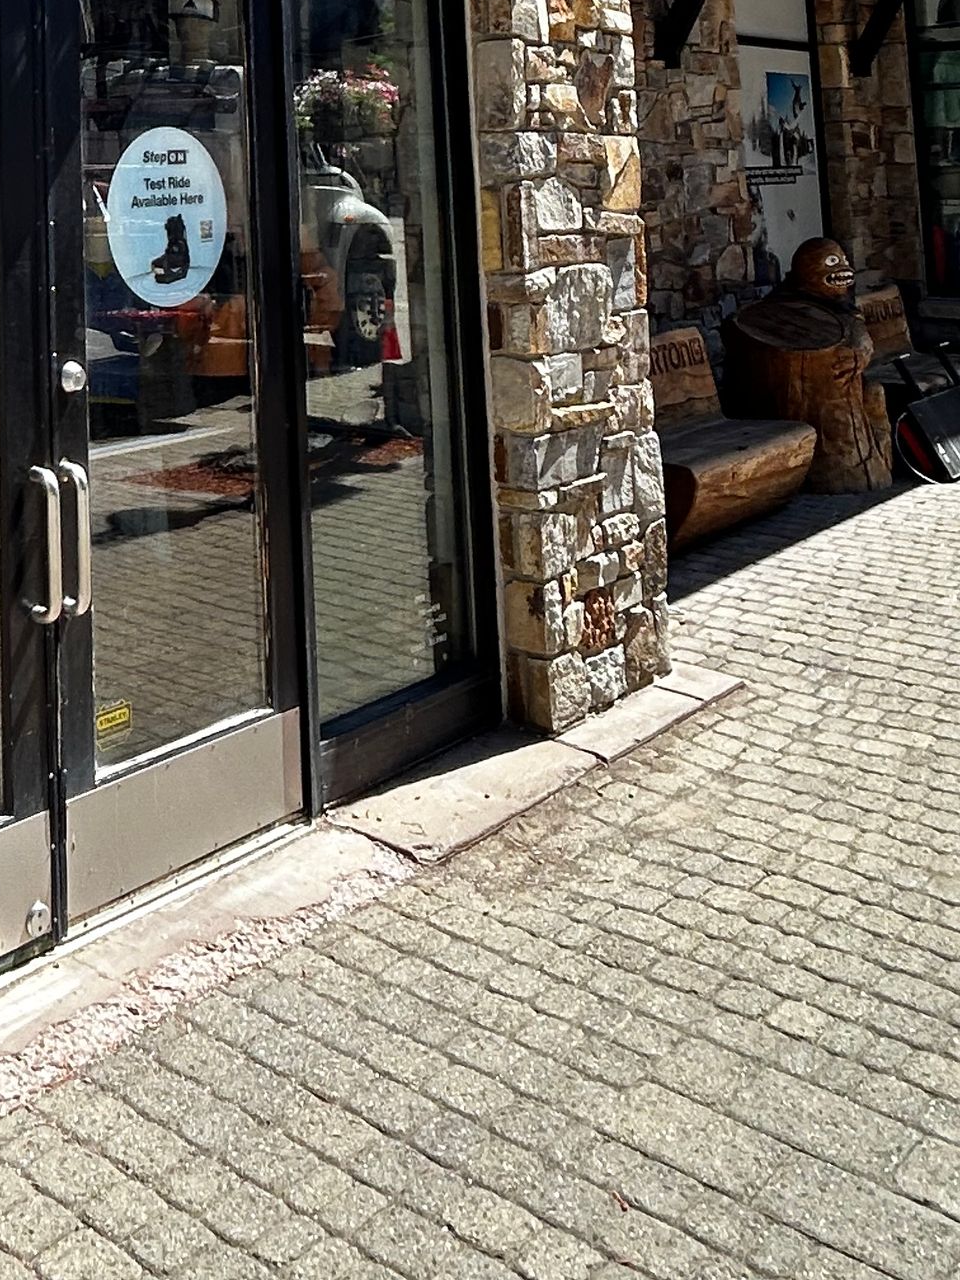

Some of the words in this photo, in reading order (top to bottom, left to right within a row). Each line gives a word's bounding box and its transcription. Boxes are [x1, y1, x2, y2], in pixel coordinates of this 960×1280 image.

[143, 177, 166, 190] Test
[168, 176, 191, 189] Ride
[131, 193, 178, 209] Available
[180, 192, 204, 205] Here
